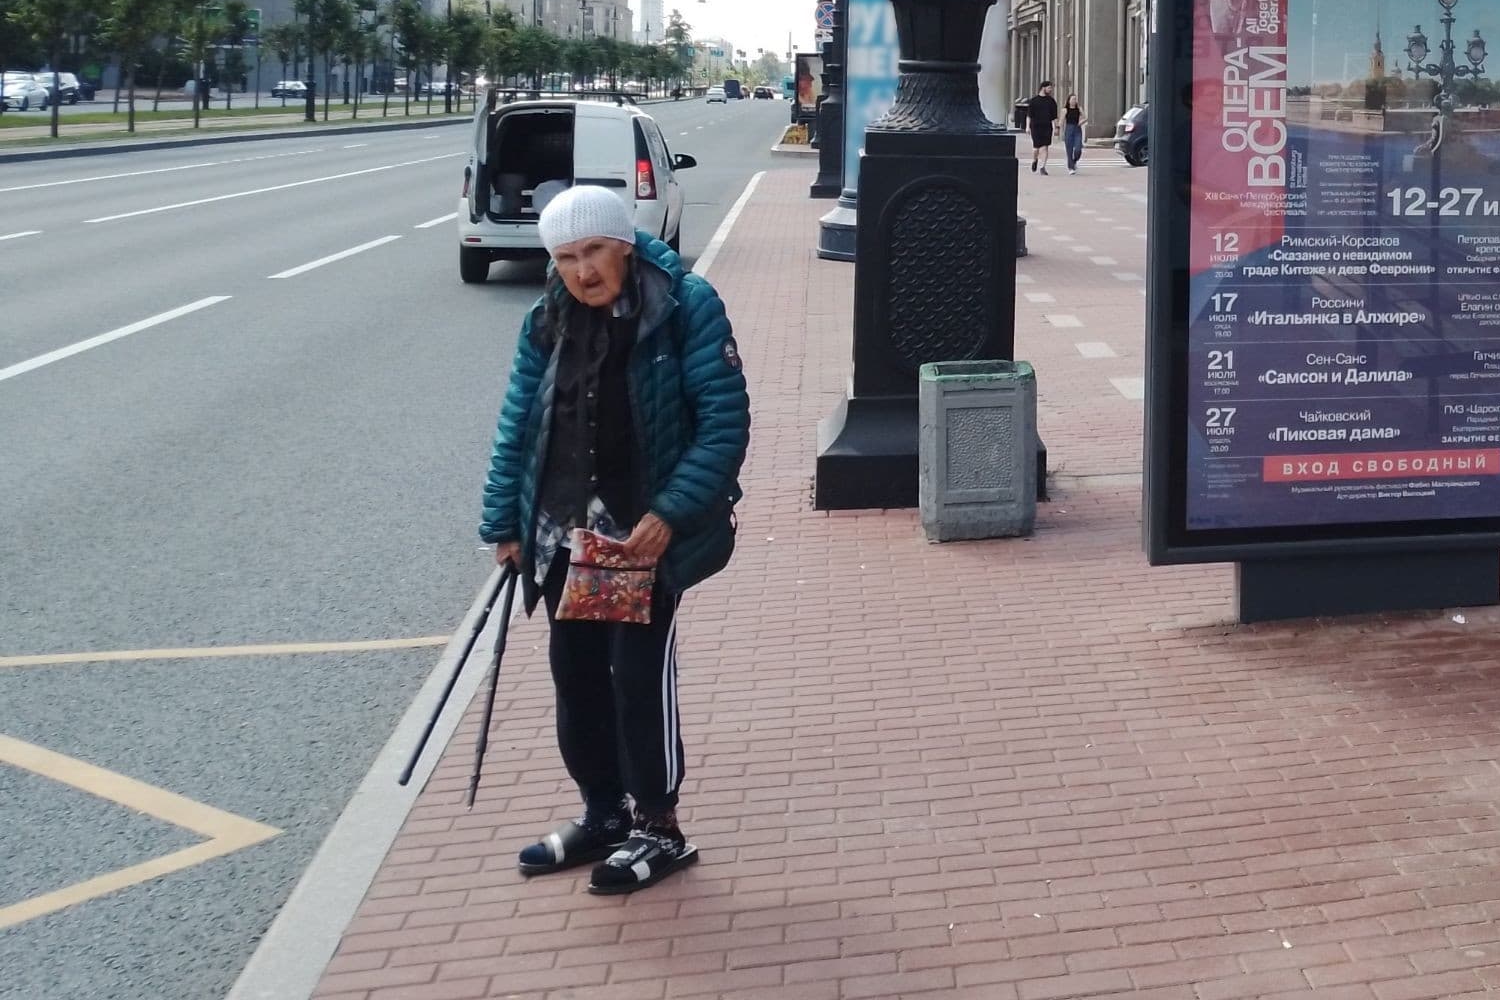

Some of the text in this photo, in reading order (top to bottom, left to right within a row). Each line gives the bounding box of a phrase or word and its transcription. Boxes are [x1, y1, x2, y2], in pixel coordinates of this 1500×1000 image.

[1246, 18, 1259, 34] All
[1222, 37, 1248, 152] ОПЕРА-
[1248, 46, 1287, 186] ВСЕМ
[1387, 187, 1483, 216] 12-27
[1212, 232, 1239, 252] 12
[1281, 235, 1400, 249] Римский-Корсаков
[1267, 249, 1412, 262] «Сказание о невидимом
[1242, 262, 1436, 277] граде Китеже и деве Февронии»
[1211, 293, 1238, 312] 17
[1311, 297, 1365, 309] Россини
[1461, 302, 1493, 311] Елагин
[1247, 310, 1426, 327] «Итальянка в Алжире»
[1207, 350, 1234, 370] 21
[1306, 353, 1367, 365] Сен-Санс
[1258, 369, 1413, 385] «Самсон и Далила»
[1206, 408, 1236, 427] 27
[1299, 409, 1371, 423] Чайковский
[1444, 405, 1464, 414] ГМЗ
[1268, 426, 1401, 442] «Пиковая дама»
[1441, 435, 1486, 443] ЗАКРЫТИЕ
[1283, 453, 1487, 475] ВХОД СВОБОДНЫЙ
